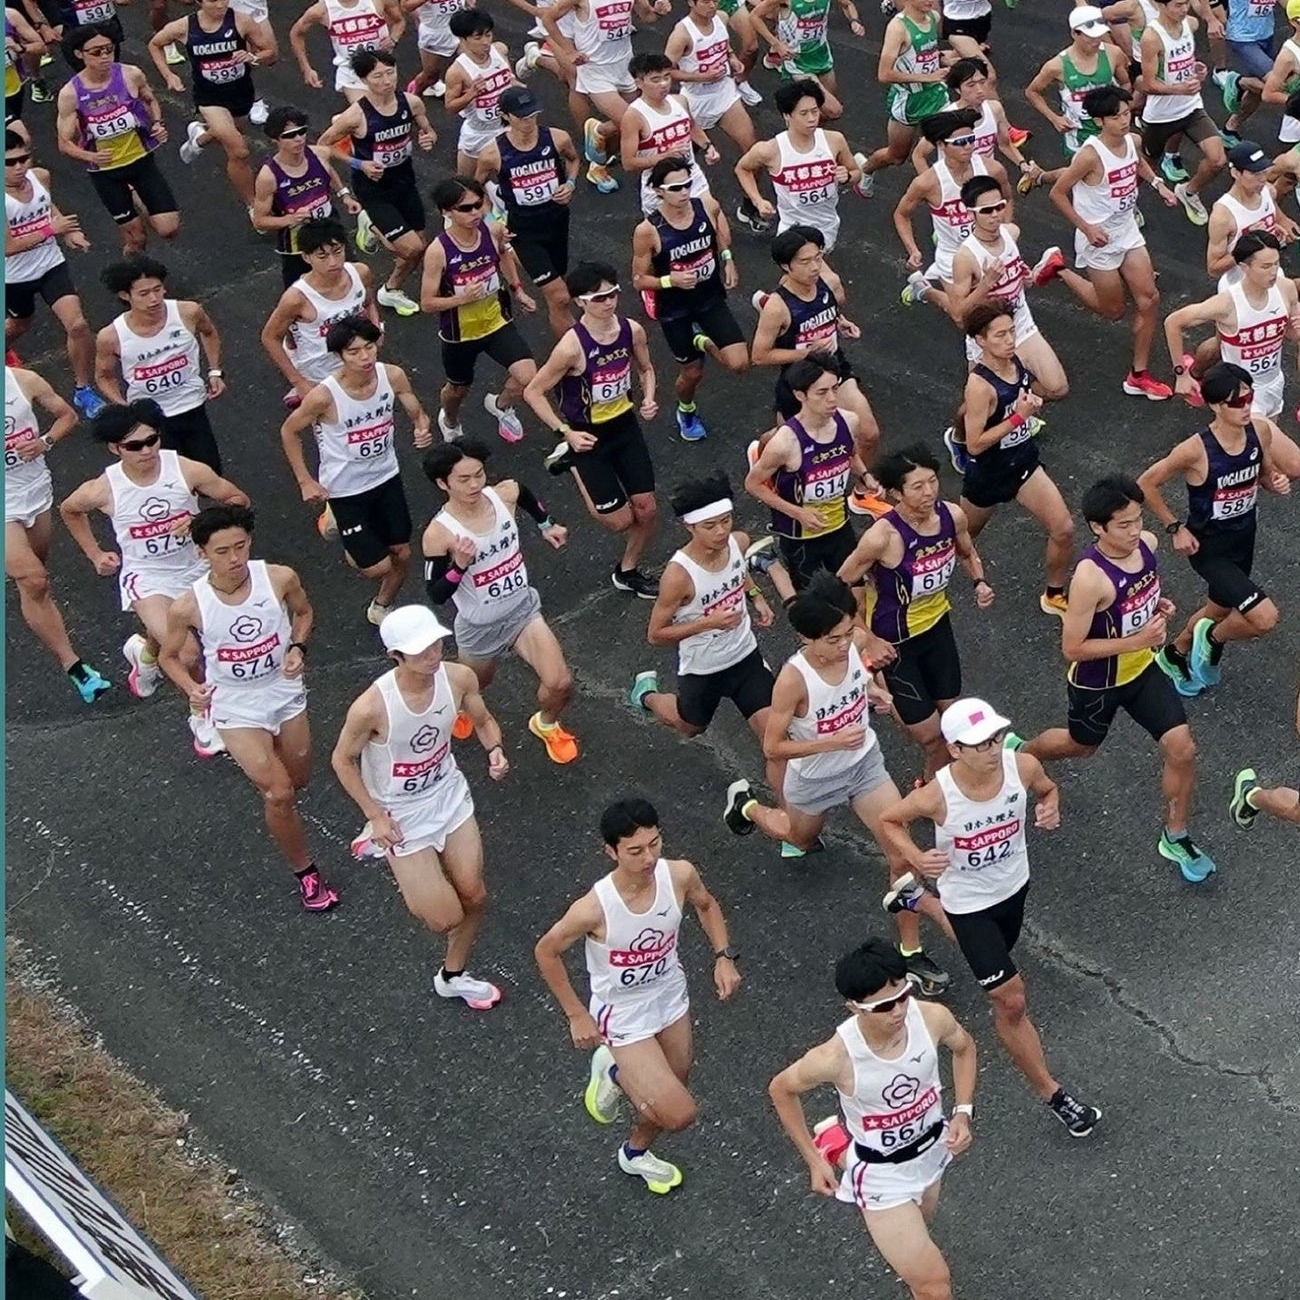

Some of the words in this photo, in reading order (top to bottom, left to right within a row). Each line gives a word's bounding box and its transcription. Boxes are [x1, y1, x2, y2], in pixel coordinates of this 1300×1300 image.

[85, 4, 113, 20] 594
[331, 17, 380, 34] 京都産大
[347, 31, 379, 45] SAPPORO
[192, 41, 237, 56] KOGAKKAN
[209, 66, 239, 82] 593
[96, 119, 129, 136] 619
[374, 123, 412, 142] KOGAKKAN
[510, 158, 556, 178] KOGAKKAN
[521, 171, 556, 187] SAPPORO
[524, 183, 553, 201] 591
[800, 187, 830, 205] 564
[670, 235, 711, 261] KOGAKKAN
[800, 306, 837, 332] KOGAKKAN
[145, 357, 187, 377] SAPPORO
[1250, 353, 1279, 373] 562
[146, 371, 182, 393] 640
[1217, 463, 1260, 490] KOGAKKAN
[815, 477, 845, 497] 614
[488, 553, 523, 580] SAPPORO
[488, 572, 523, 597] 646
[232, 653, 275, 678] 674
[971, 822, 1018, 849] SAPPORO
[968, 840, 1010, 867] 642
[621, 959, 666, 985] 670
[881, 1088, 936, 1128] SAPPORO
[881, 1114, 926, 1147] 667
